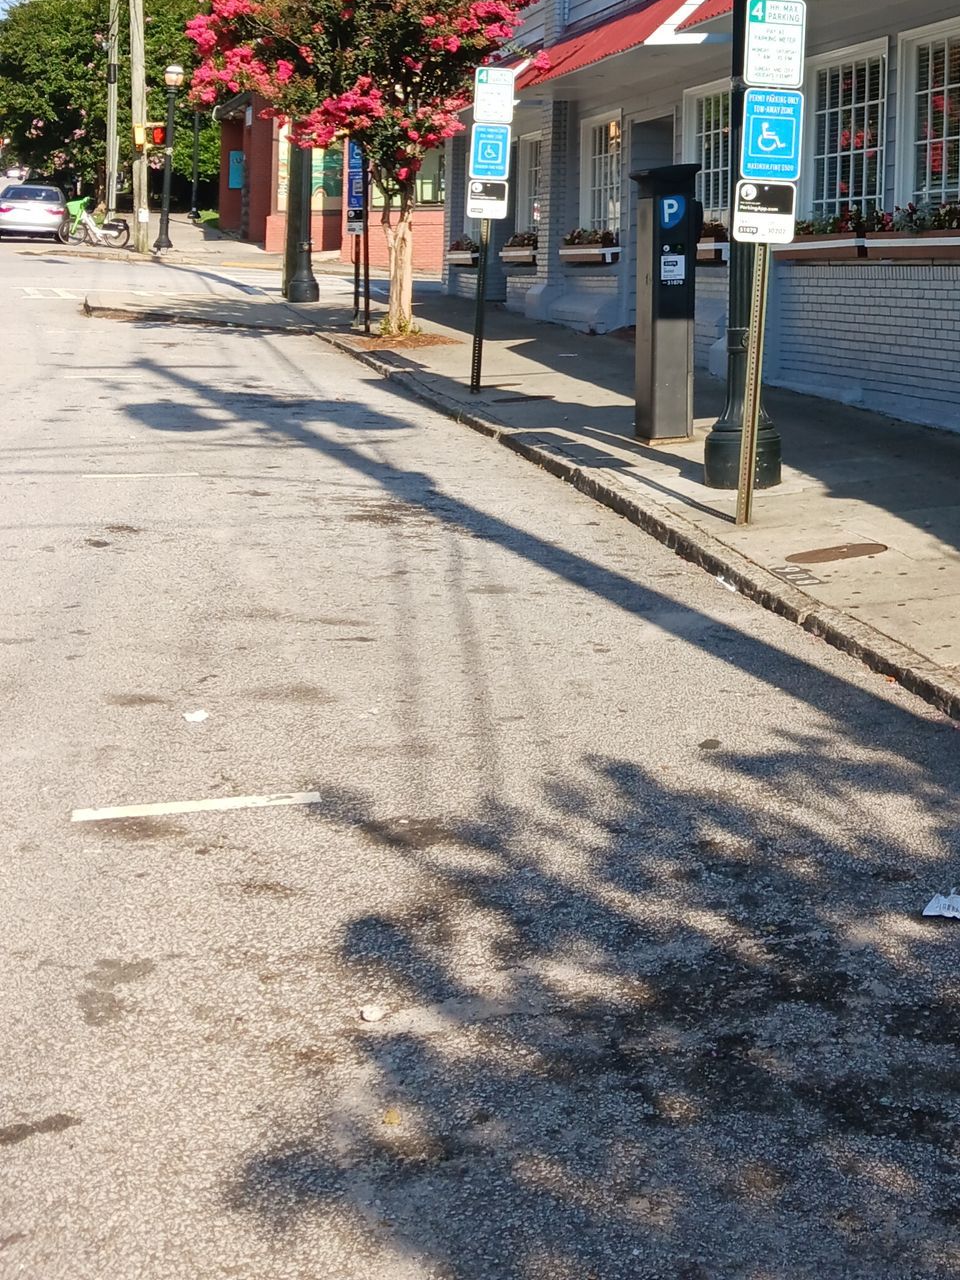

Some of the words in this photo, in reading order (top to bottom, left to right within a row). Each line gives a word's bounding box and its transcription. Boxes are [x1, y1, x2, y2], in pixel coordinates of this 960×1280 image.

[752, 2, 763, 20] 4
[768, 12, 800, 22] PARKING
[479, 70, 488, 82] 4
[766, 95, 787, 104] PARKING
[754, 105, 780, 113] TOW-AWAY
[663, 199, 679, 223] P
